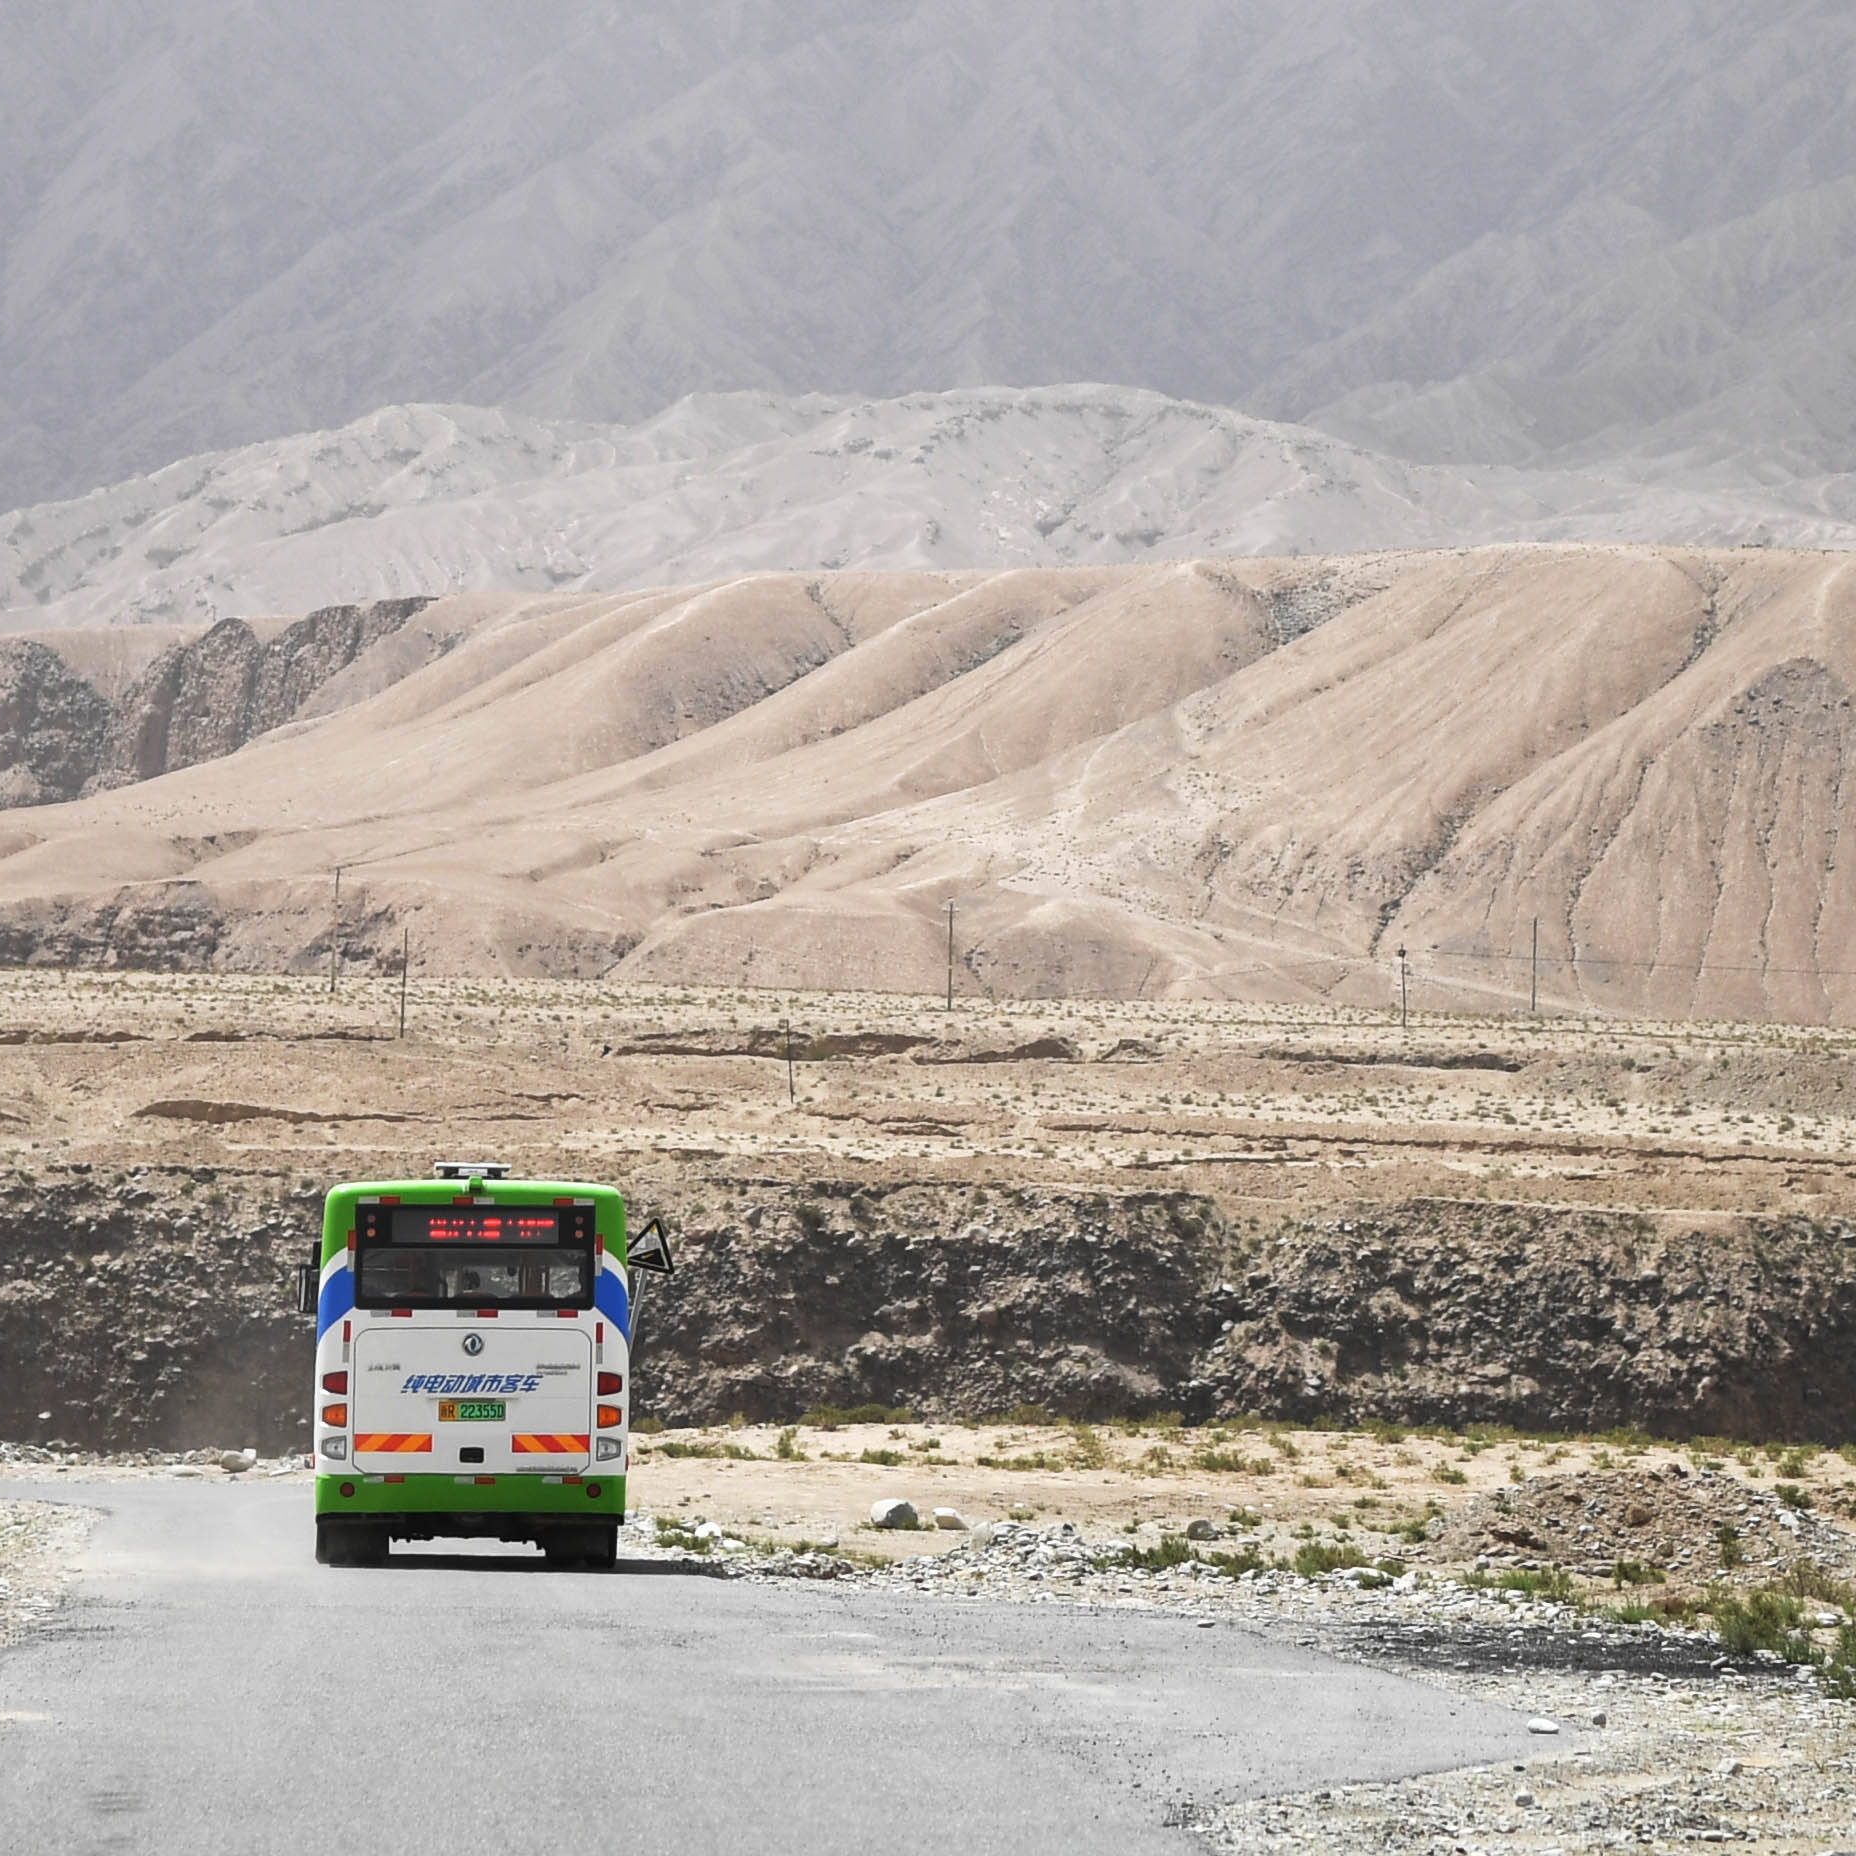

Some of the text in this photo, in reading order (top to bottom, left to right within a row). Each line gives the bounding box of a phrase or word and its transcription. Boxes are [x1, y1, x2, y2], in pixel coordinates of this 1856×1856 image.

[401, 1374, 543, 1393] 纯电动城市客车
